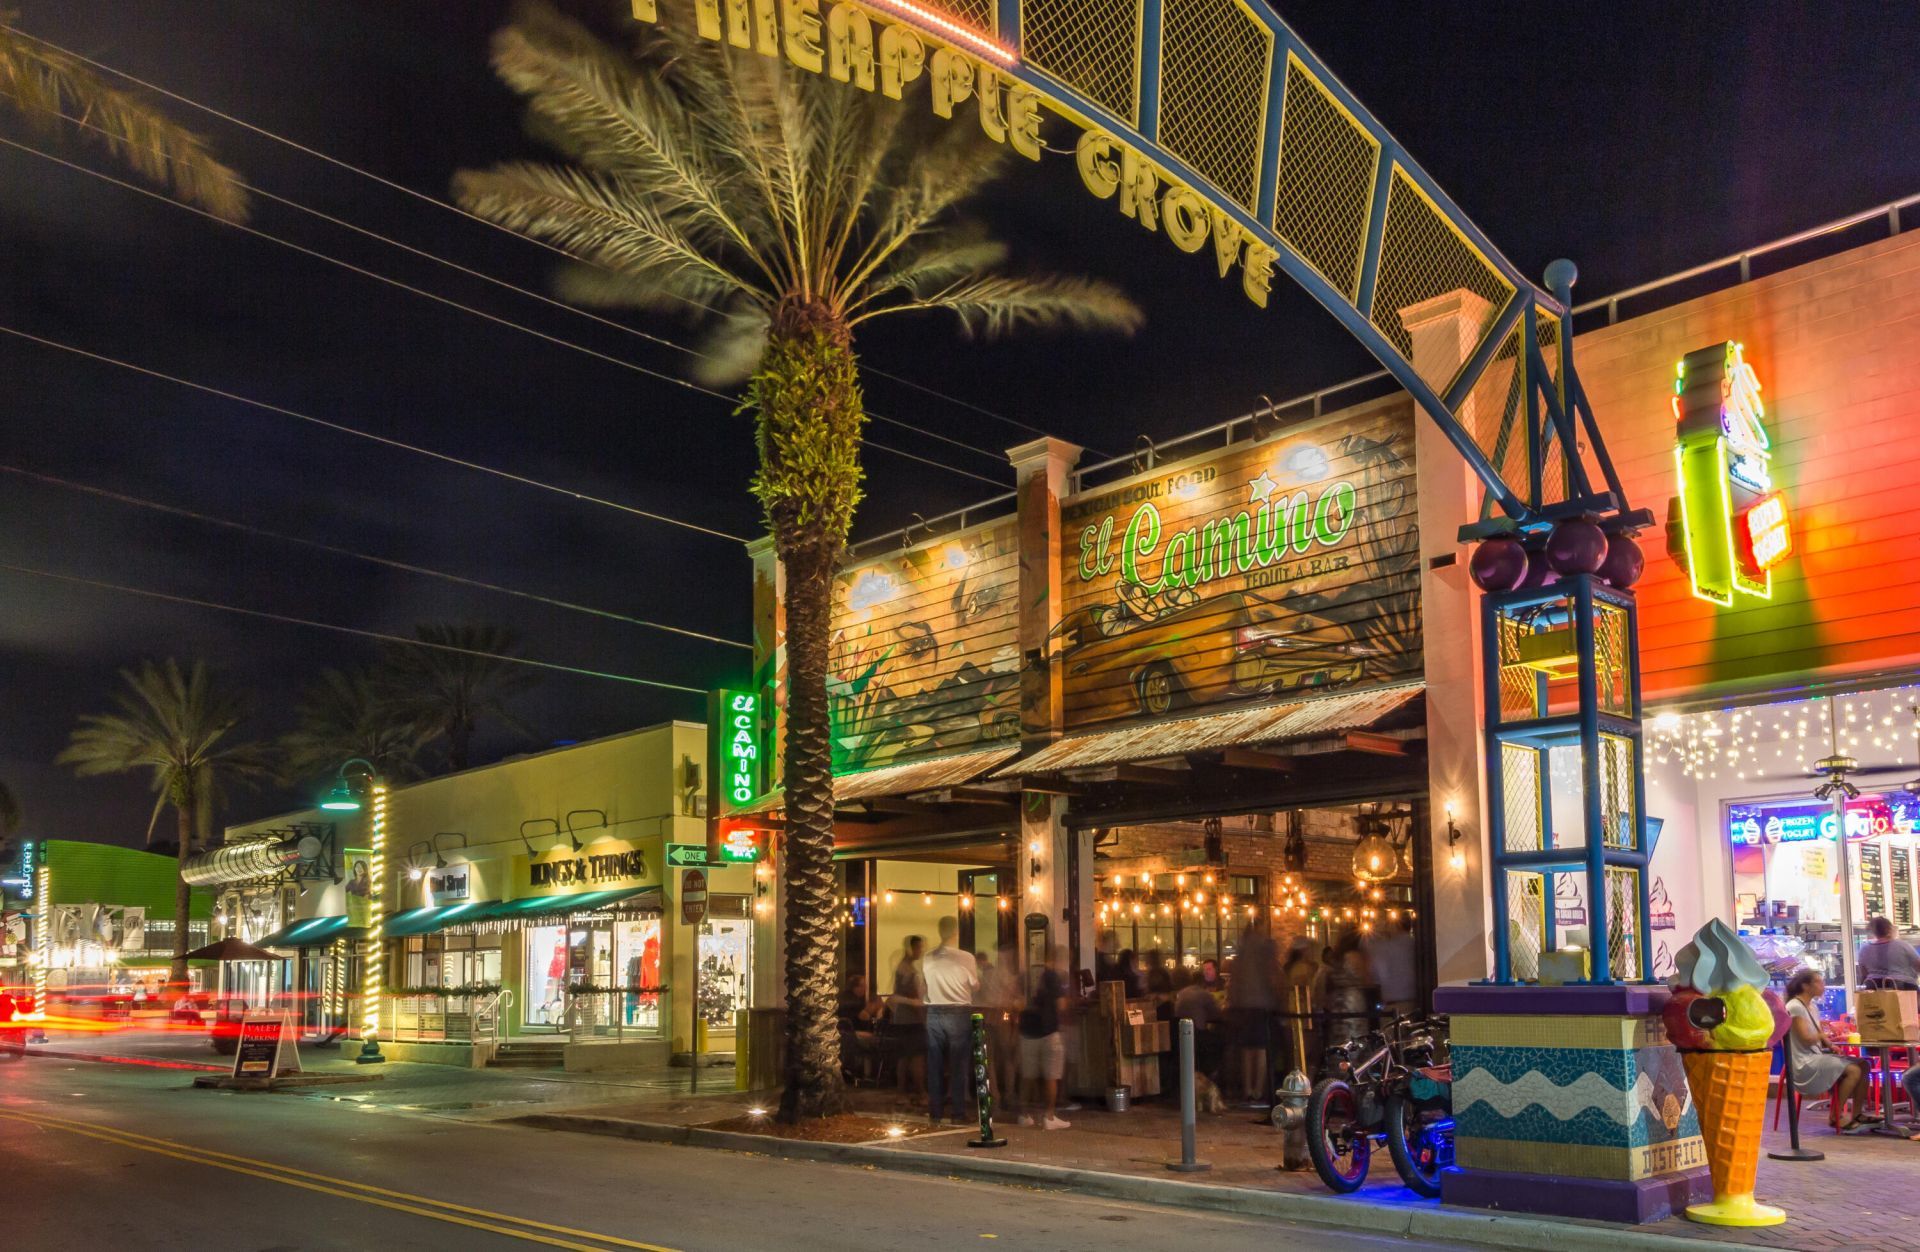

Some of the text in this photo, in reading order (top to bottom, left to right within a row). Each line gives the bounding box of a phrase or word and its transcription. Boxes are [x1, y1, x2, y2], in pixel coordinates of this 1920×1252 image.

[1076, 129, 1281, 309] GROVE
[1123, 482, 1164, 507] SOUL
[1167, 466, 1217, 495] FOOD
[1078, 480, 1357, 596] El Camino
[1243, 555, 1351, 589] TEQUILA BAR
[732, 716, 756, 802] CAMINO
[1781, 816, 1815, 826] FROZEN
[1781, 827, 1816, 839] YOGURT
[588, 849, 644, 879] THINGS
[684, 851, 702, 860] ONE
[693, 879, 704, 889] NOT
[684, 904, 704, 913] ENTER
[247, 1024, 279, 1032] VALET
[1643, 1139, 1703, 1174] DISTRICT
